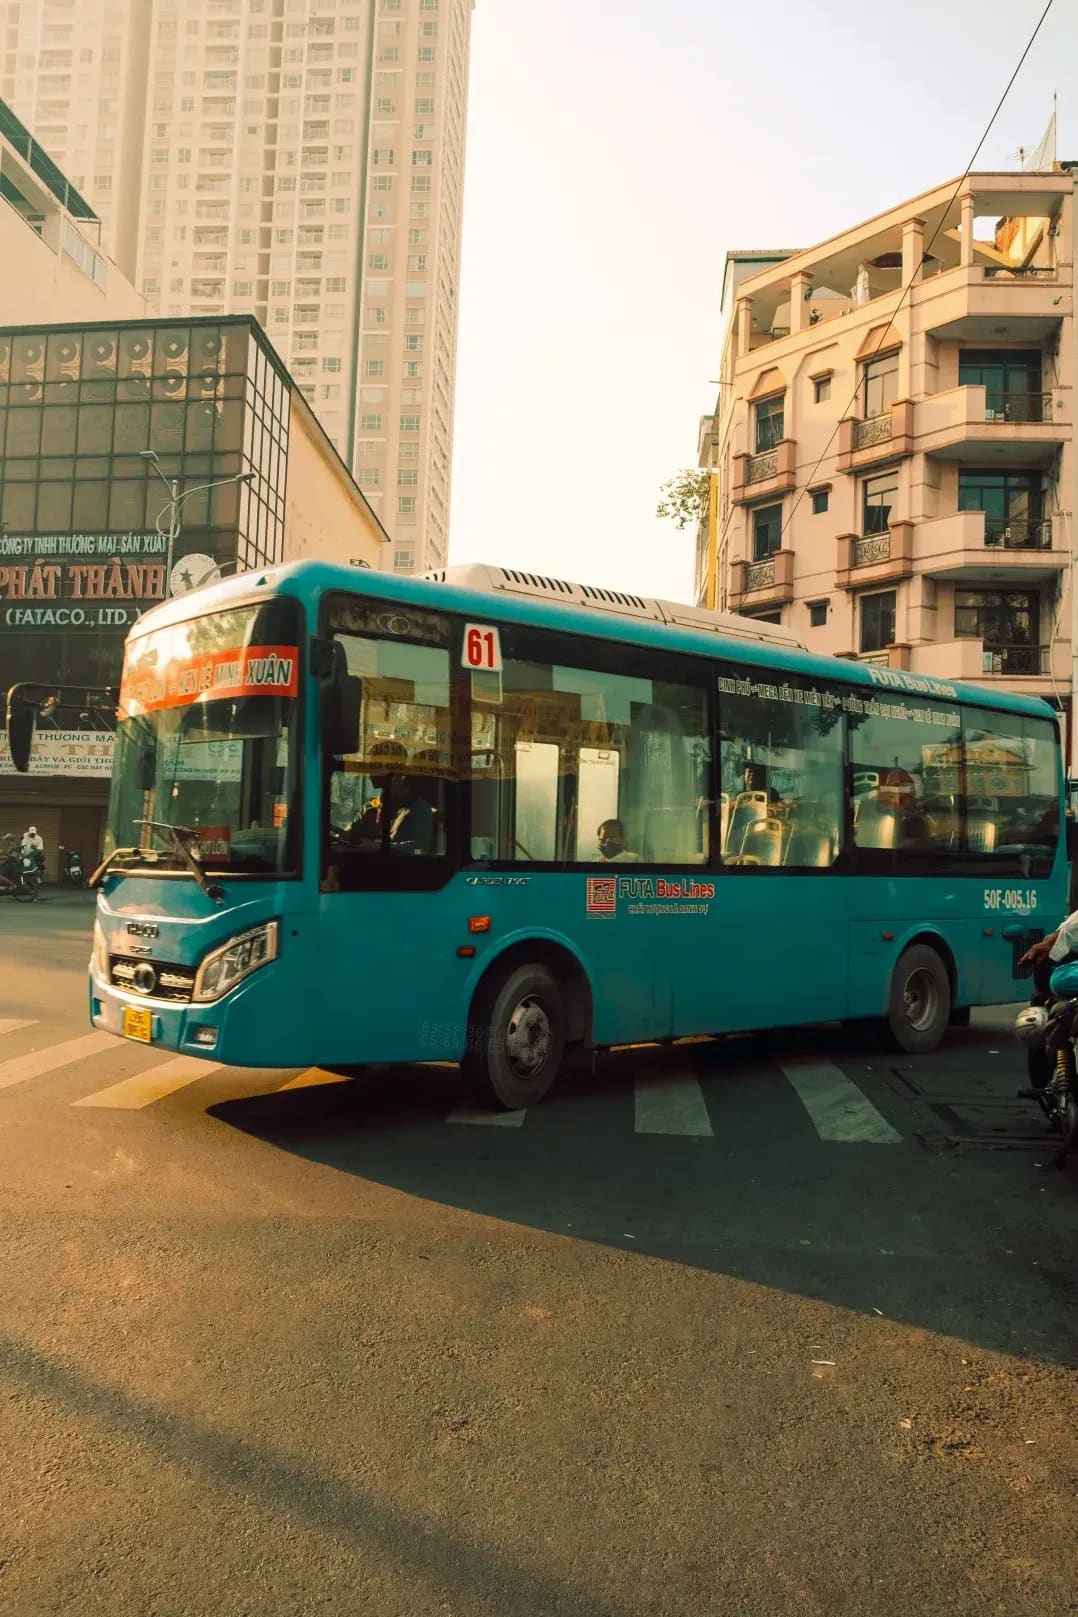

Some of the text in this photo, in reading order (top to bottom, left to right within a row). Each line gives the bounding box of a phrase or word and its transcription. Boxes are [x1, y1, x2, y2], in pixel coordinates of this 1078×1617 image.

[23, 537, 33, 554] TY
[34, 537, 57, 553] TNHH
[69, 556, 166, 599] THÀNH
[467, 629, 494, 667] 61
[245, 653, 293, 687] XUÂN
[867, 668, 905, 689] FUTA
[619, 878, 715, 899] FUTA Bus Lines
[984, 889, 1037, 909] 50F-005.16
